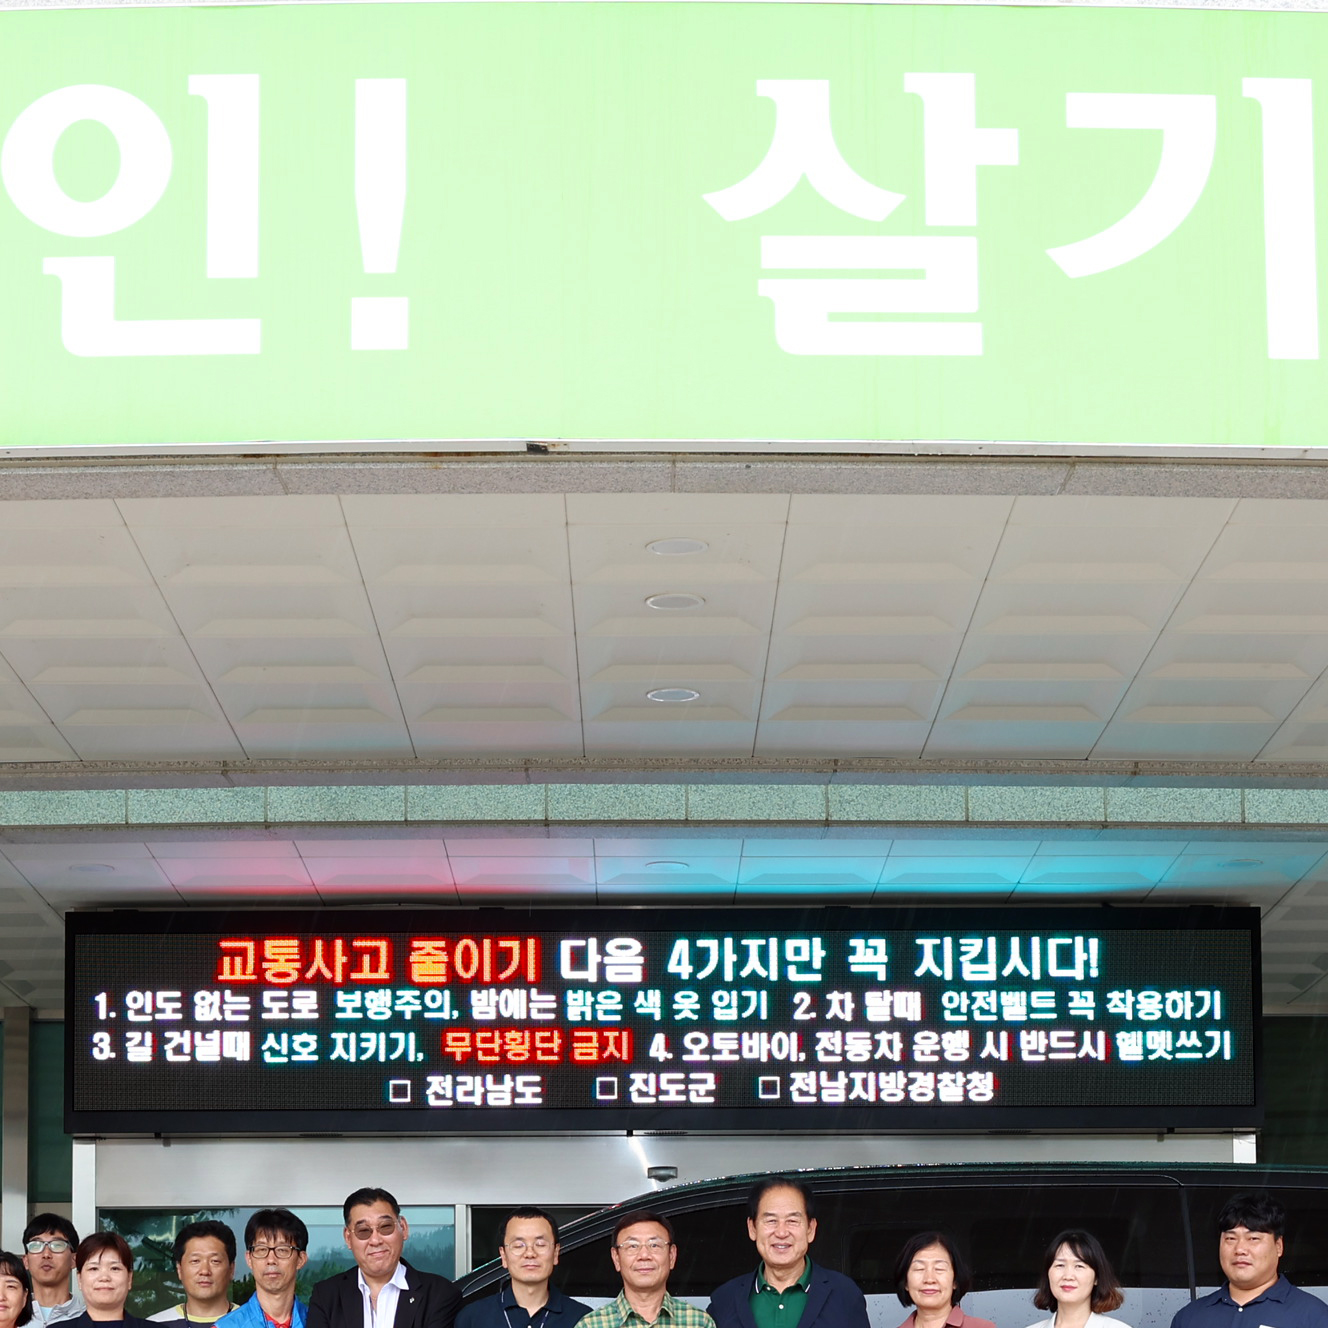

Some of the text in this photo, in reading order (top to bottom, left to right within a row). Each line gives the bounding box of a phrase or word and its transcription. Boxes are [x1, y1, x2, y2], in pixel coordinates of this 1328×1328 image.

[218, 936, 1099, 983] 교통사고 줄이기 다음 4가지만 꼭 지킵시다!
[94, 989, 1222, 1021] 1. 인도 없는 도로 보행주의, 밤에는 밝은 색 옷 입기 2. 차 탈때 안전벨트 꼭 착용하기
[92, 1030, 1232, 1062] 3. 길 건널때 신호 지키기, 무단횡단 금지 4. 오토바이, 전동차 운행 시 반드시 헬멧쓰기
[426, 1073, 543, 1106] 전라남도
[629, 1072, 716, 1104] 진도군
[789, 1071, 994, 1102] 전남지방경찰청
